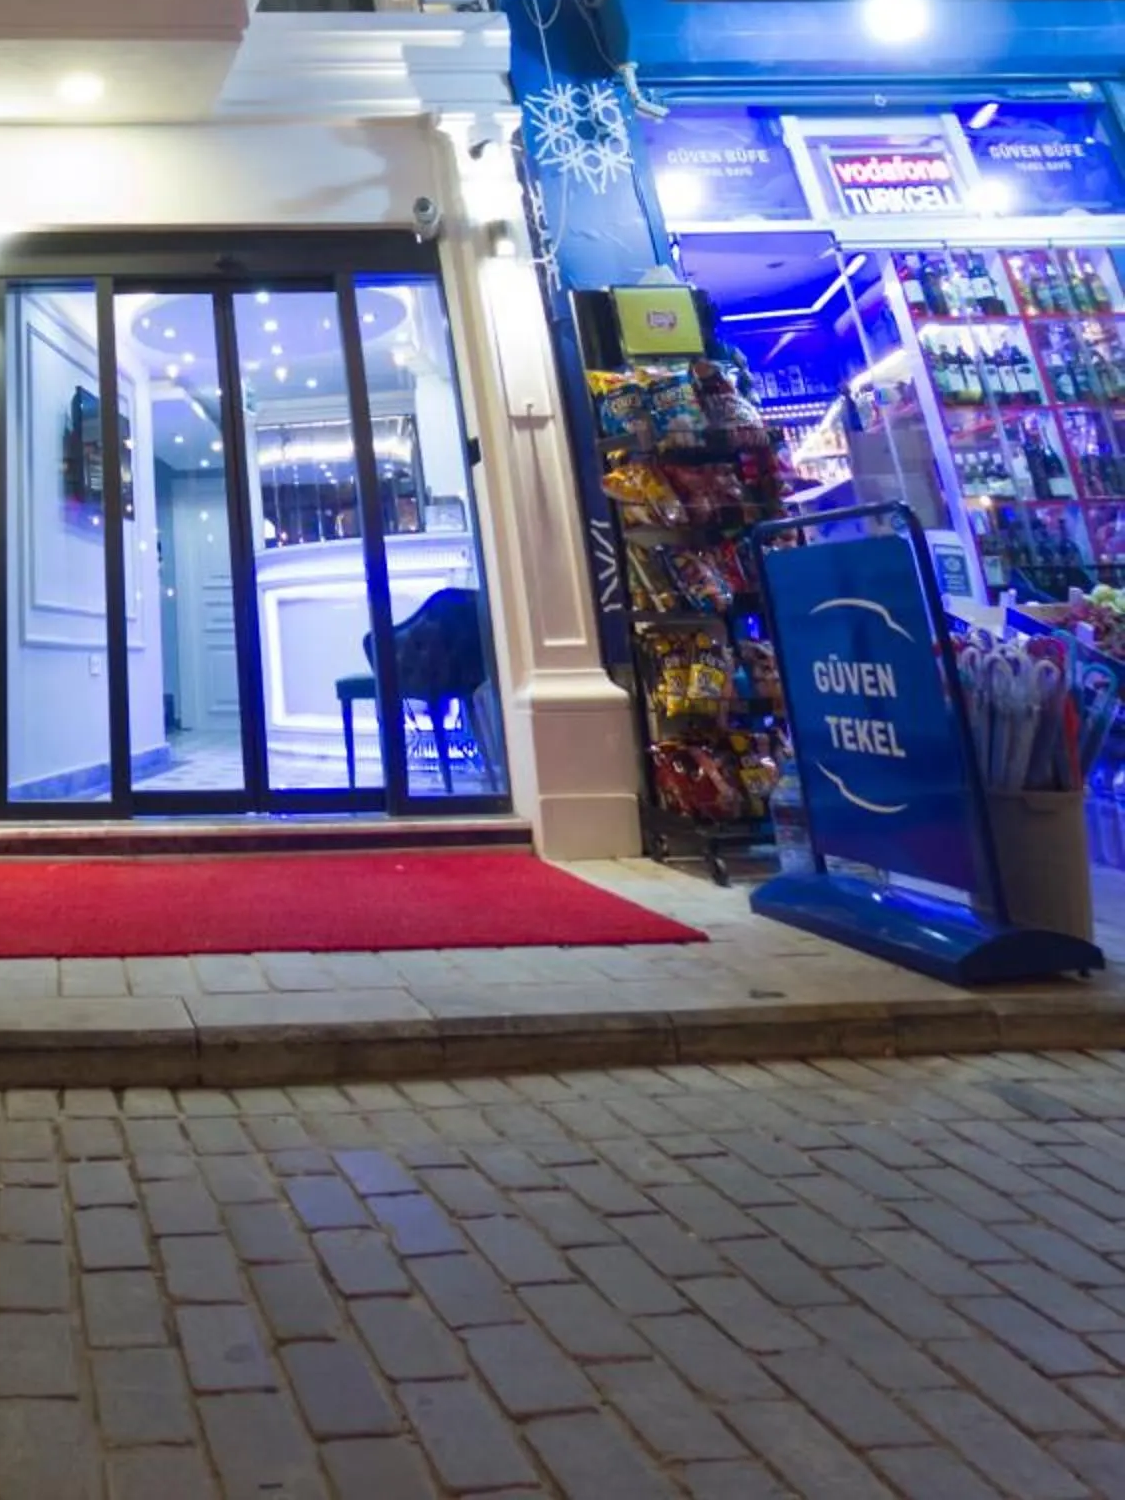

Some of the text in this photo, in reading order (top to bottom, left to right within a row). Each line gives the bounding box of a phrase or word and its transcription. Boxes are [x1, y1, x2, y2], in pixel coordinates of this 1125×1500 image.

[835, 155, 951, 182] vodafone
[845, 185, 964, 213] TURKCELL
[813, 653, 897, 698] GÜVEN
[824, 715, 906, 758] TEKEL
